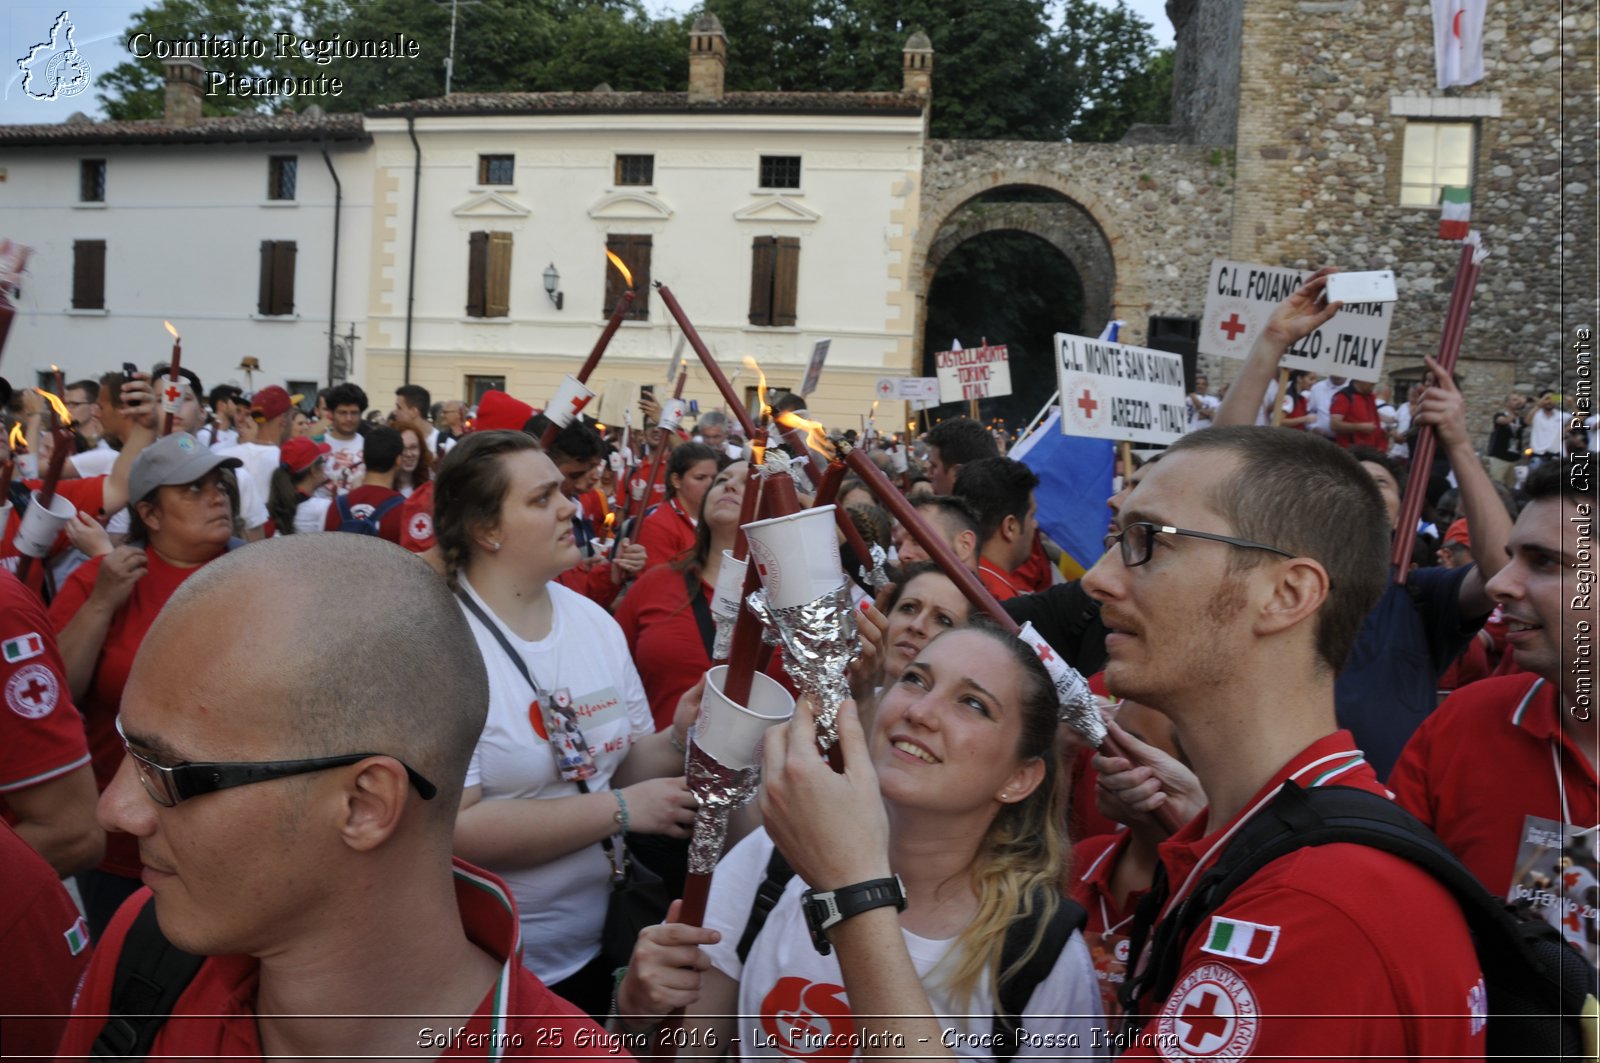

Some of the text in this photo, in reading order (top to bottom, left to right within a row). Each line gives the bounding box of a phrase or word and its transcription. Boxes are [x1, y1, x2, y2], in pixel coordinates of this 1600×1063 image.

[1217, 266, 1242, 297] C.L.
[935, 345, 1008, 368] CASTELLAMONTE
[1062, 339, 1182, 388] C.L. MONTE SAN SAVINO
[1334, 333, 1383, 369] ITALY
[1111, 396, 1152, 430] AREZZO
[1159, 403, 1185, 434] ITALY
